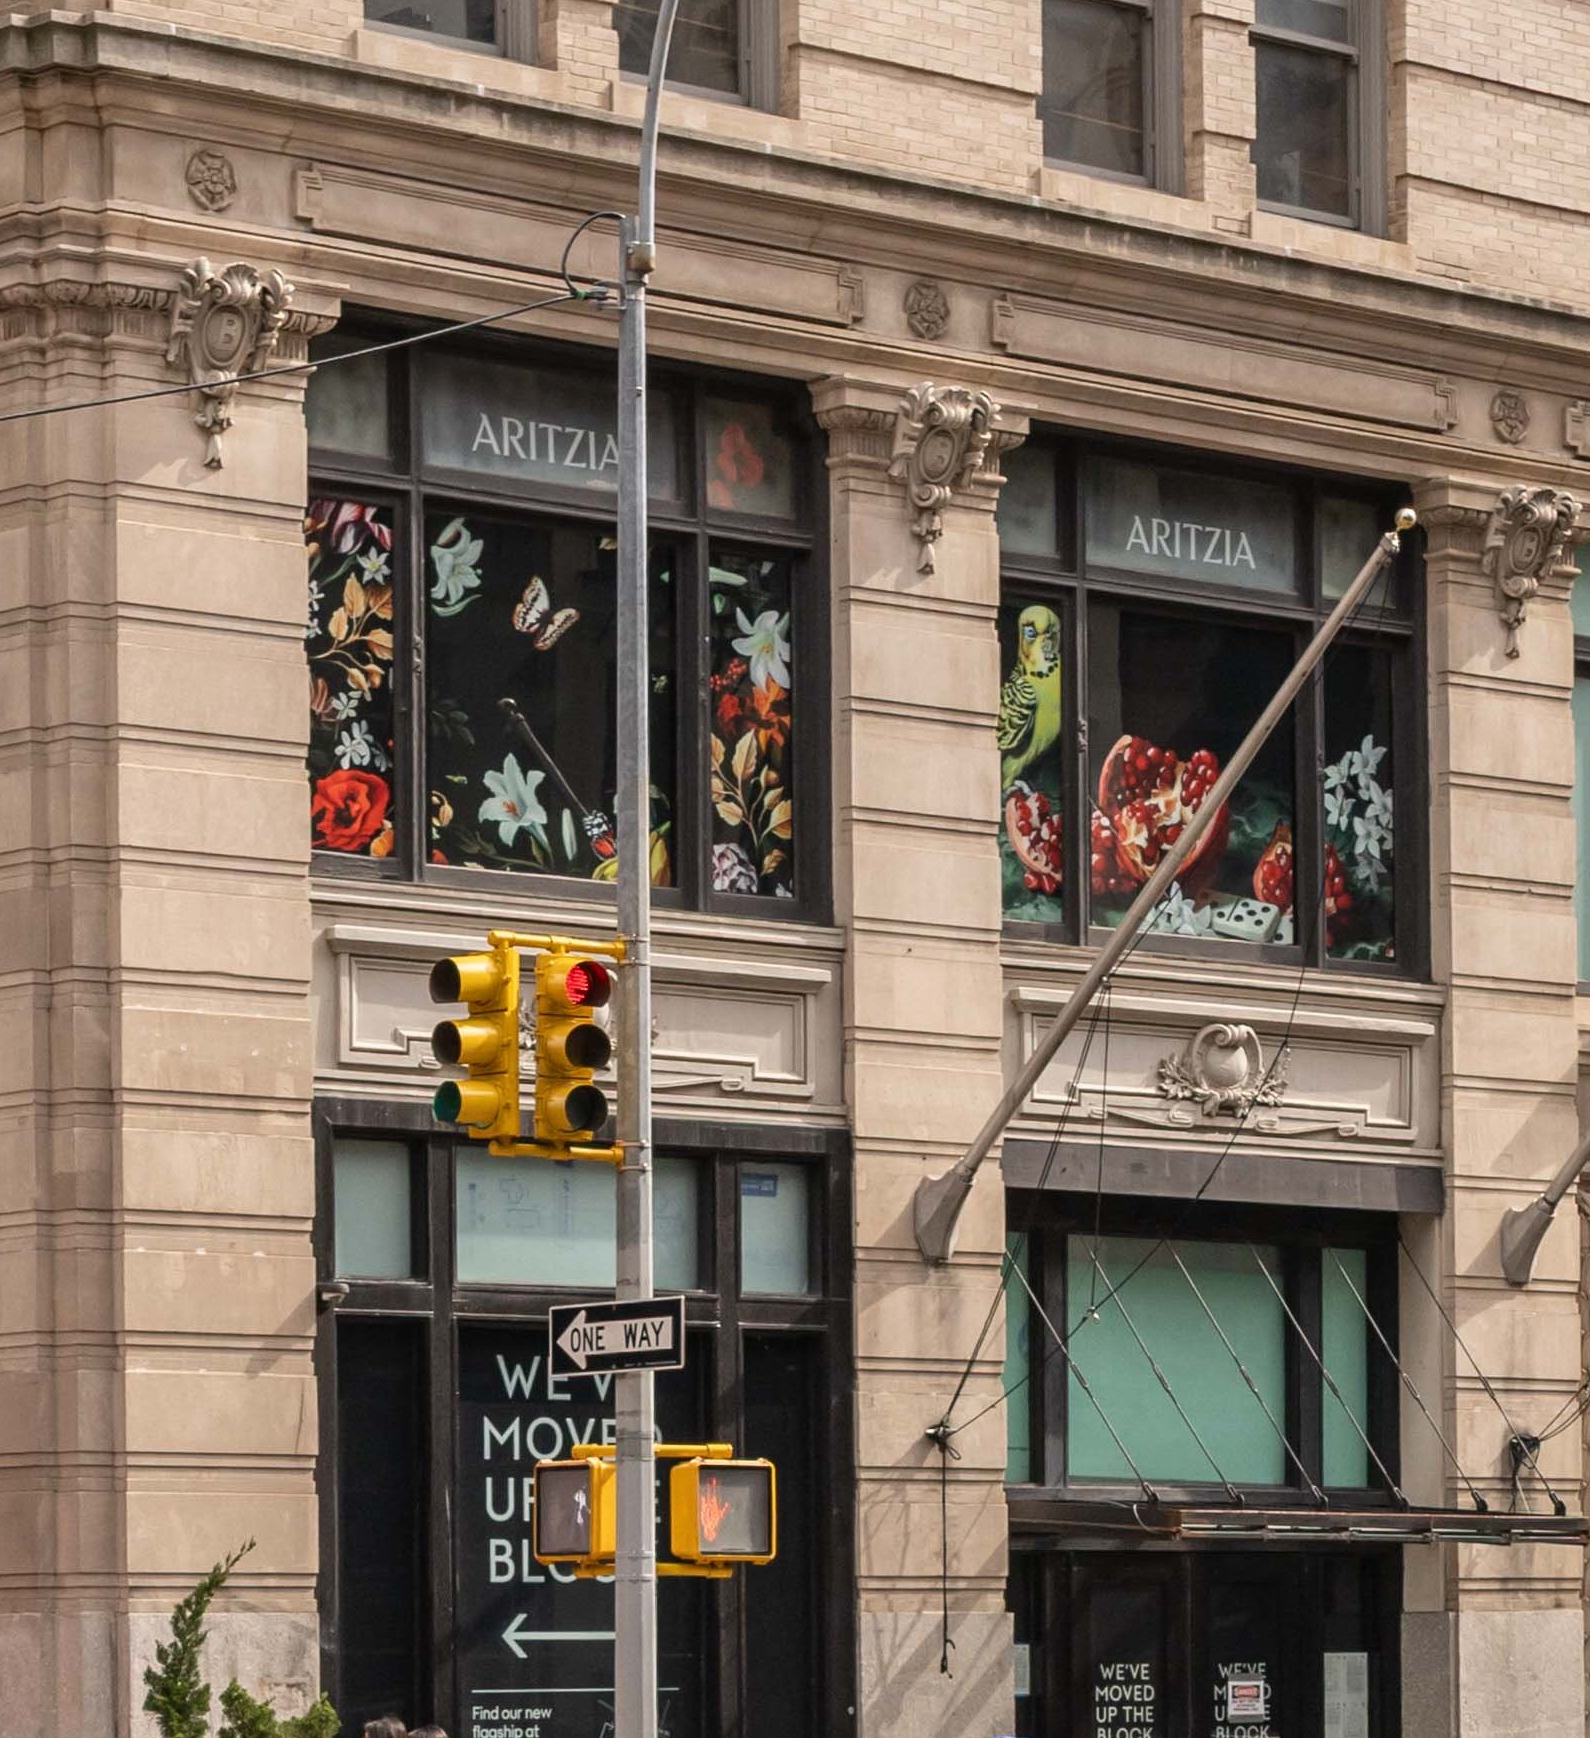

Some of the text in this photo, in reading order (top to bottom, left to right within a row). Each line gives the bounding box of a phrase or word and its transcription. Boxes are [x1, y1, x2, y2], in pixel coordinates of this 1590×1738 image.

[471, 412, 619, 471] ARITZIA
[1126, 515, 1256, 570] ARITZIA
[570, 1321, 665, 1352] ONE WAY
[496, 1354, 613, 1401] WEV
[1100, 1663, 1151, 1681] WE'VE
[1095, 1684, 1155, 1702] MOVED
[472, 1706, 553, 1720] Find our new
[1095, 1706, 1155, 1723] UP THE
[525, 1726, 540, 1738] at
